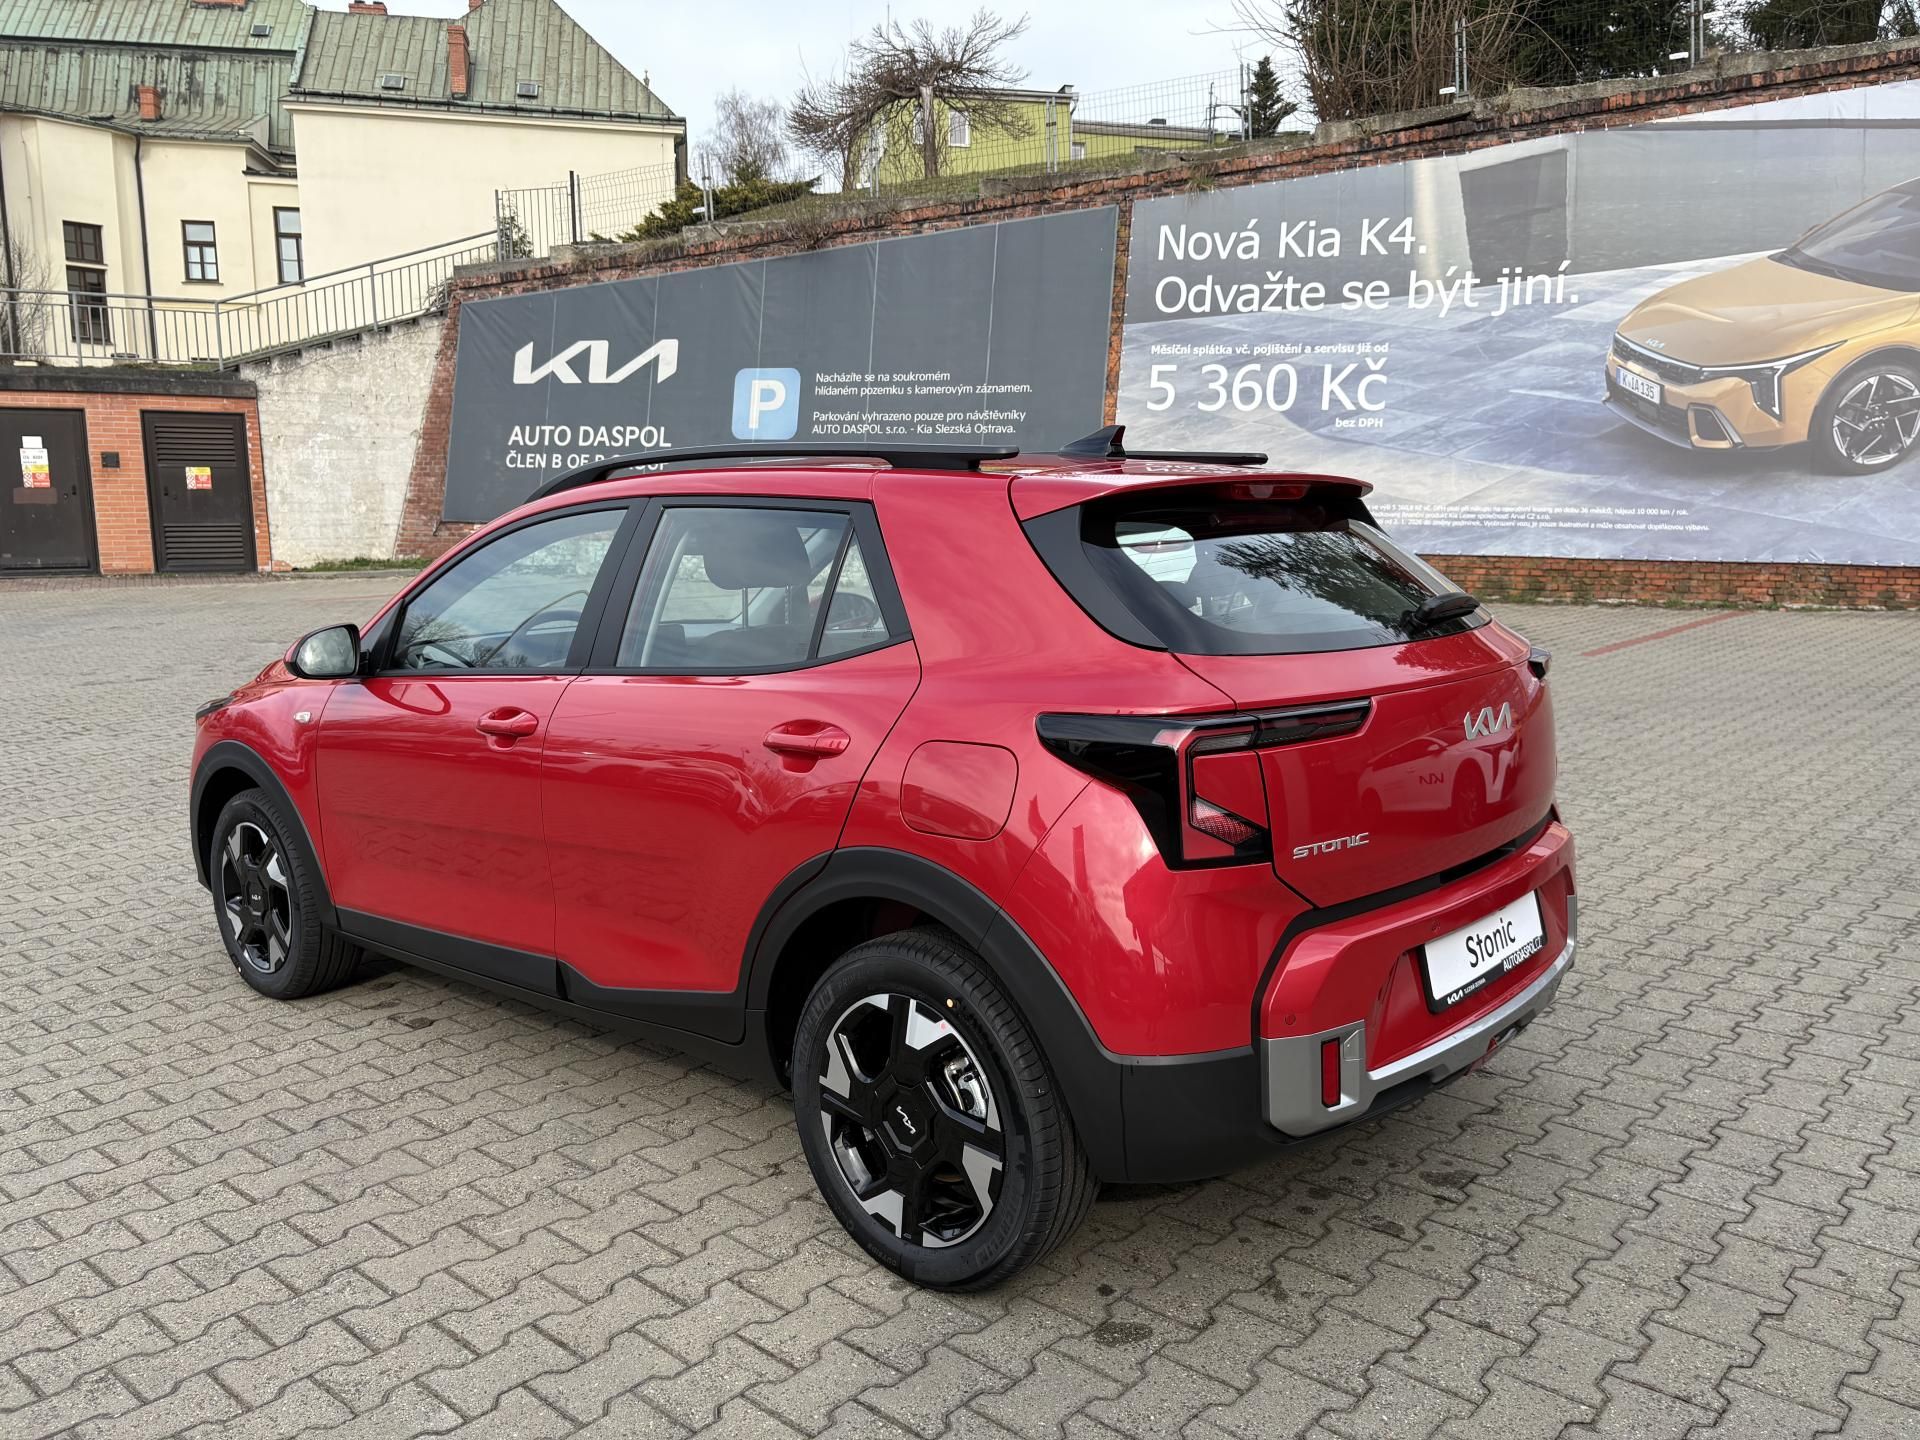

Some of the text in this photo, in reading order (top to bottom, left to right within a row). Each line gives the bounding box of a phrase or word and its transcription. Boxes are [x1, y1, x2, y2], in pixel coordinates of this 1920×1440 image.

[1157, 217, 1428, 261] Nová Kia K4.
[1154, 260, 1579, 318] Odvažte se být jiní.
[1151, 342, 1389, 357] Měsíční splátka vč. pojištění a servisu již od
[815, 371, 951, 383] Nacházíte se na soukromém
[1146, 357, 1388, 412] 5 360 Kč
[814, 382, 1033, 397] hlídaném pozemku s kamerovým záznamem.
[748, 379, 786, 429] P
[812, 410, 1026, 423] Parkování vyhrazeno pouze pro návštěvníky
[1335, 417, 1384, 429] bez DPH
[507, 426, 672, 448] AUTO DASPOL
[811, 424, 840, 435] AUTO
[842, 424, 883, 435] DASPOL
[885, 425, 908, 435] s.r.o.
[916, 424, 933, 434] Kia
[935, 423, 972, 434] Slezská
[974, 423, 1017, 434] Ostrava.
[505, 450, 547, 468] ČLEN
[551, 453, 562, 468] B
[1292, 832, 1370, 860] STONIC
[1465, 917, 1516, 968] Stonic
